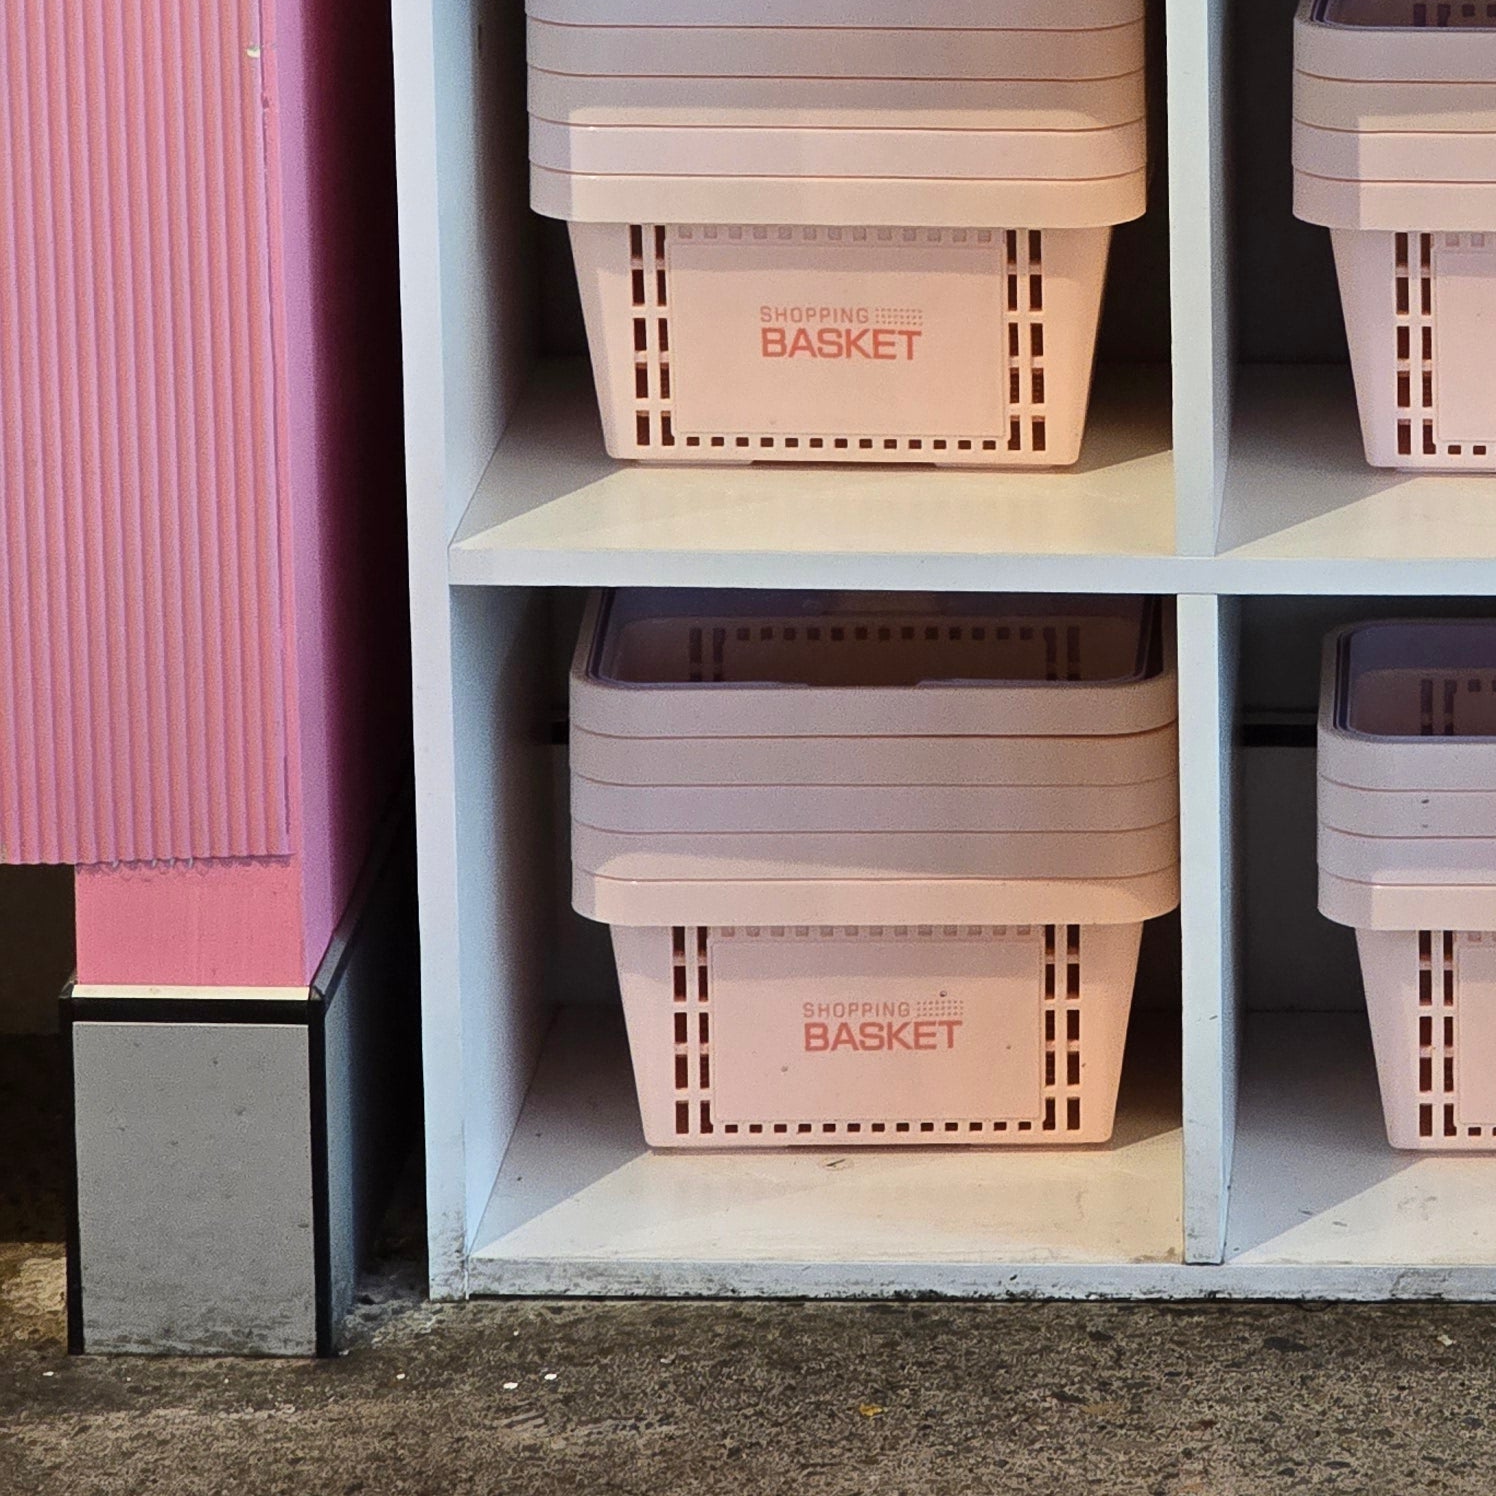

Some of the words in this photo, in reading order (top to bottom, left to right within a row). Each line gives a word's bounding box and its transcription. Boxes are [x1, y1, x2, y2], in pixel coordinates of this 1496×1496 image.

[759, 306, 870, 325] SHOPPING
[762, 327, 922, 360] BASKET
[803, 1001, 911, 1019] SHOPPING
[805, 1020, 962, 1051] BASKET
